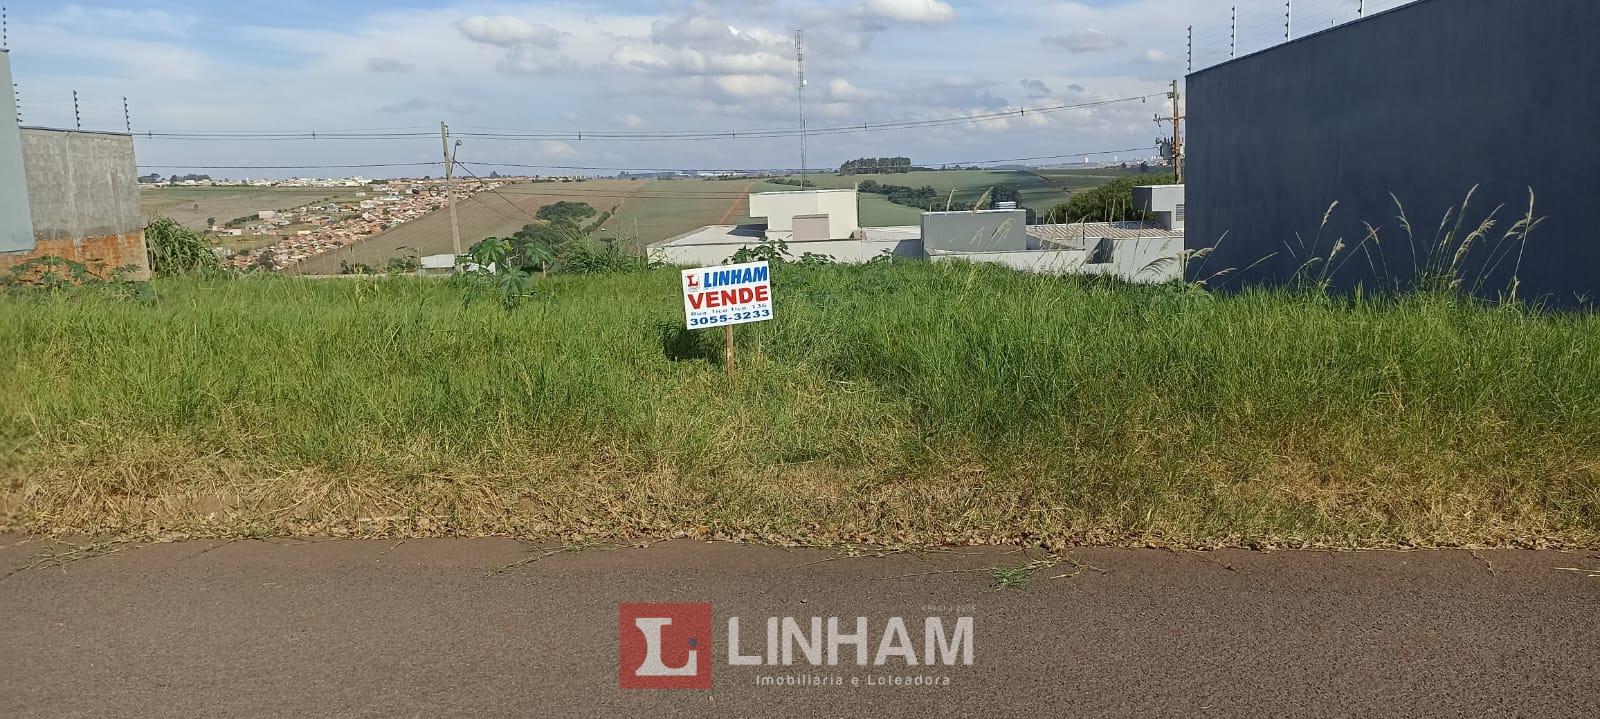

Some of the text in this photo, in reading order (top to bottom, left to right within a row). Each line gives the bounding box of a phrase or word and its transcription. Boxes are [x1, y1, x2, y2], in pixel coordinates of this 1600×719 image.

[703, 266, 768, 288] LINHAM
[687, 285, 769, 309] VENDE
[690, 309, 770, 326] 3055-3233
